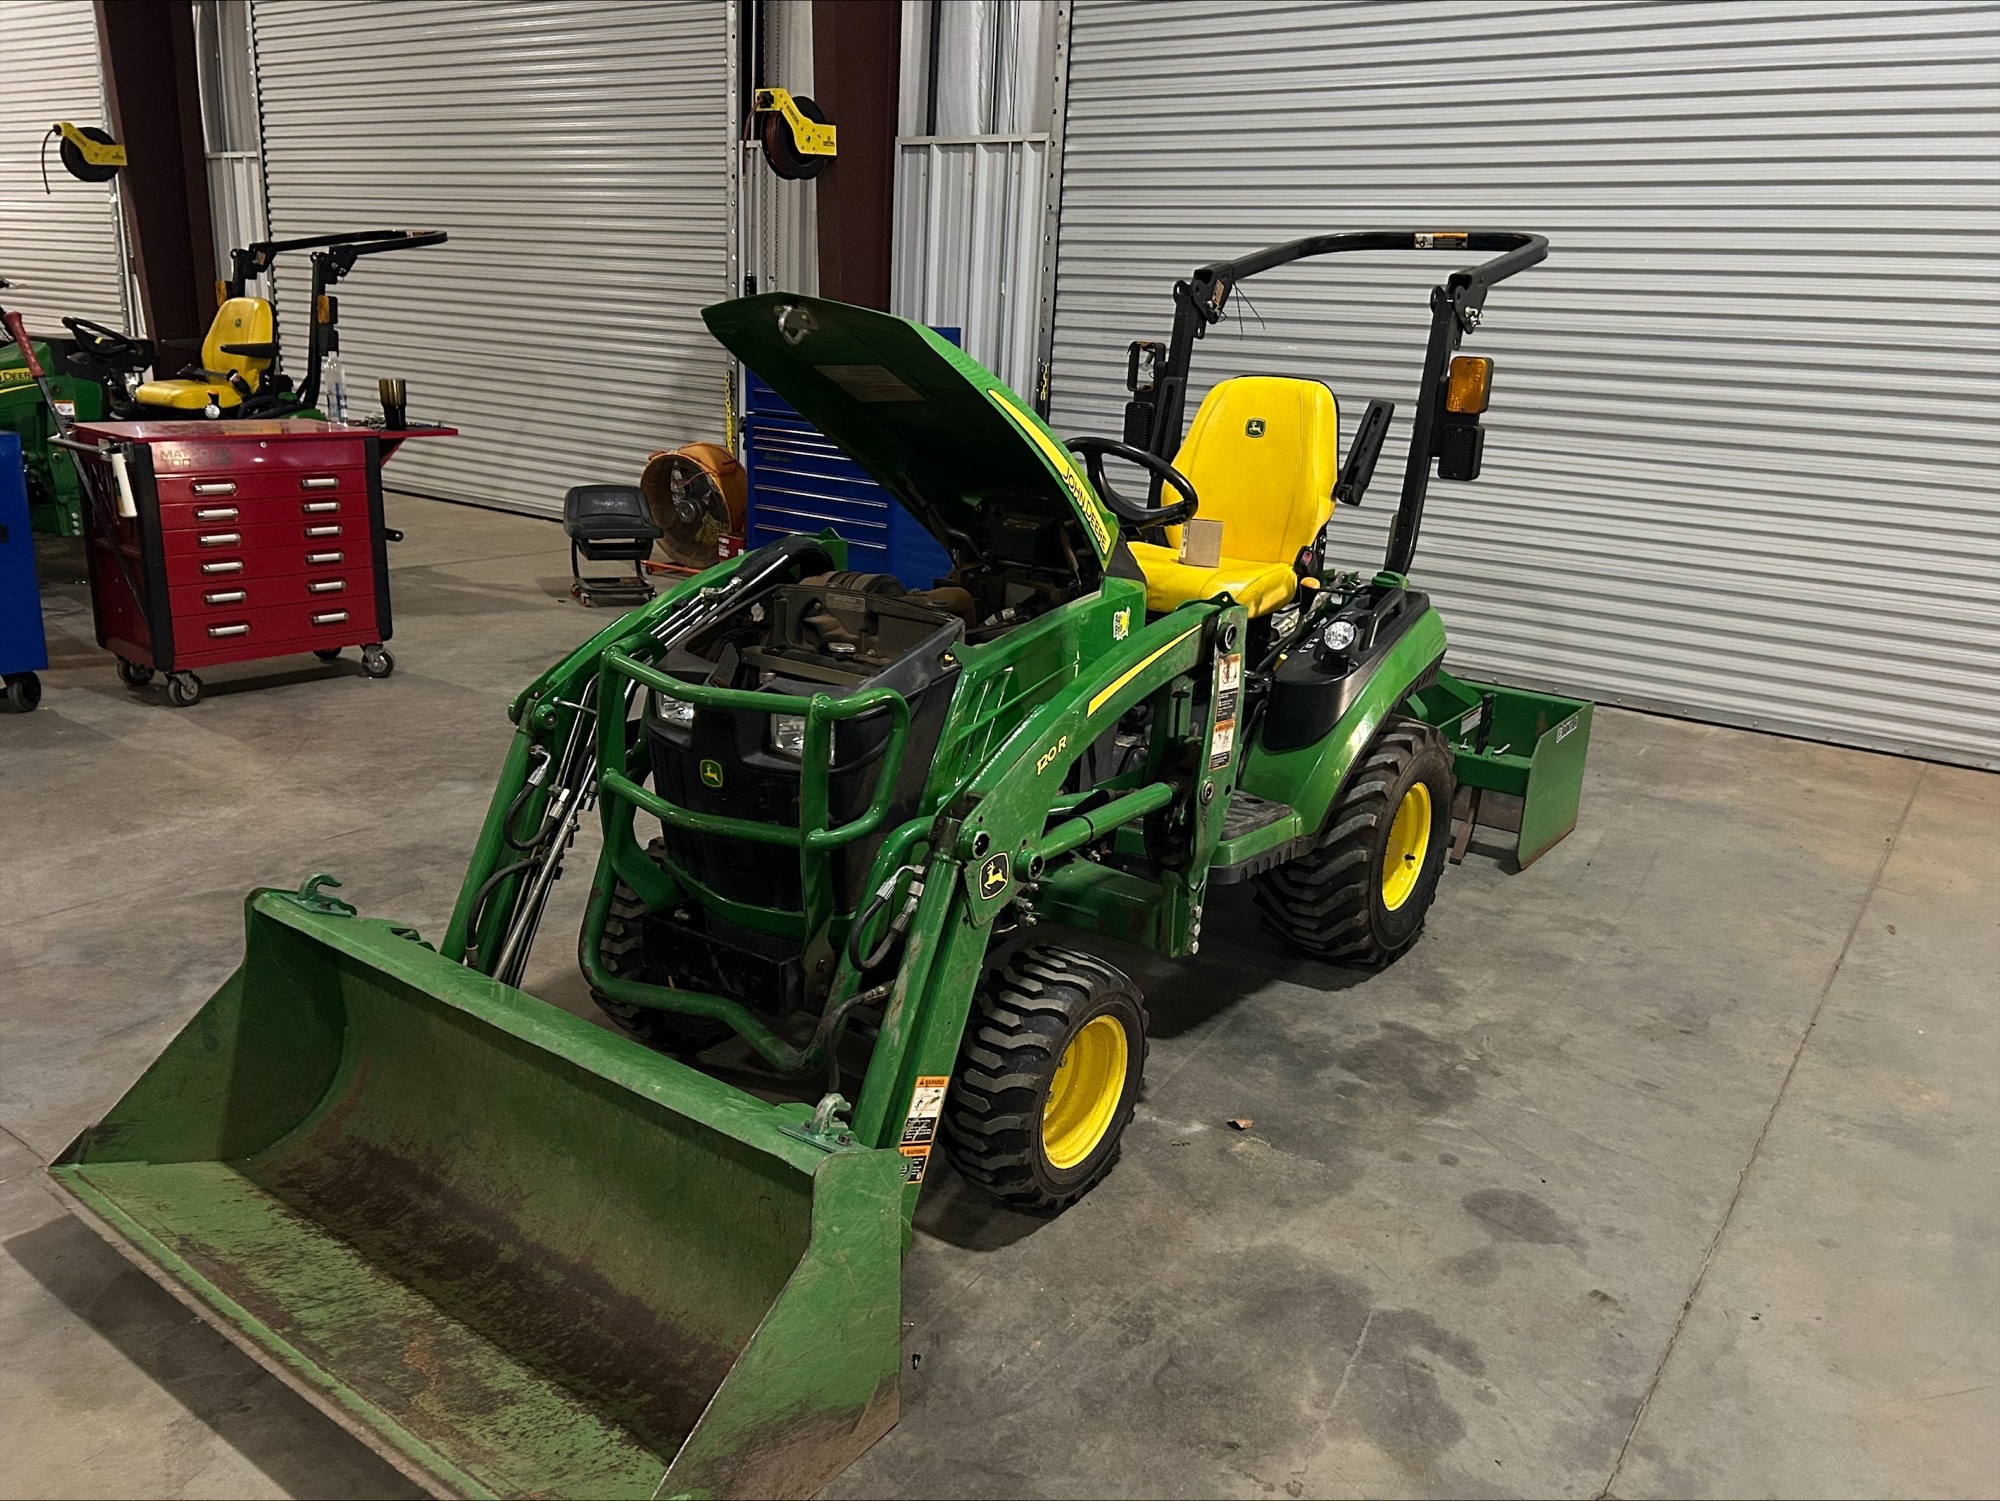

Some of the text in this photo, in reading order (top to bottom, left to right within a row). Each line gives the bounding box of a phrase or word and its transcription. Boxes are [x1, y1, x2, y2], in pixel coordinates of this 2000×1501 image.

[3, 371, 31, 381] DEER
[1063, 466, 1107, 551] JOHN DEERE
